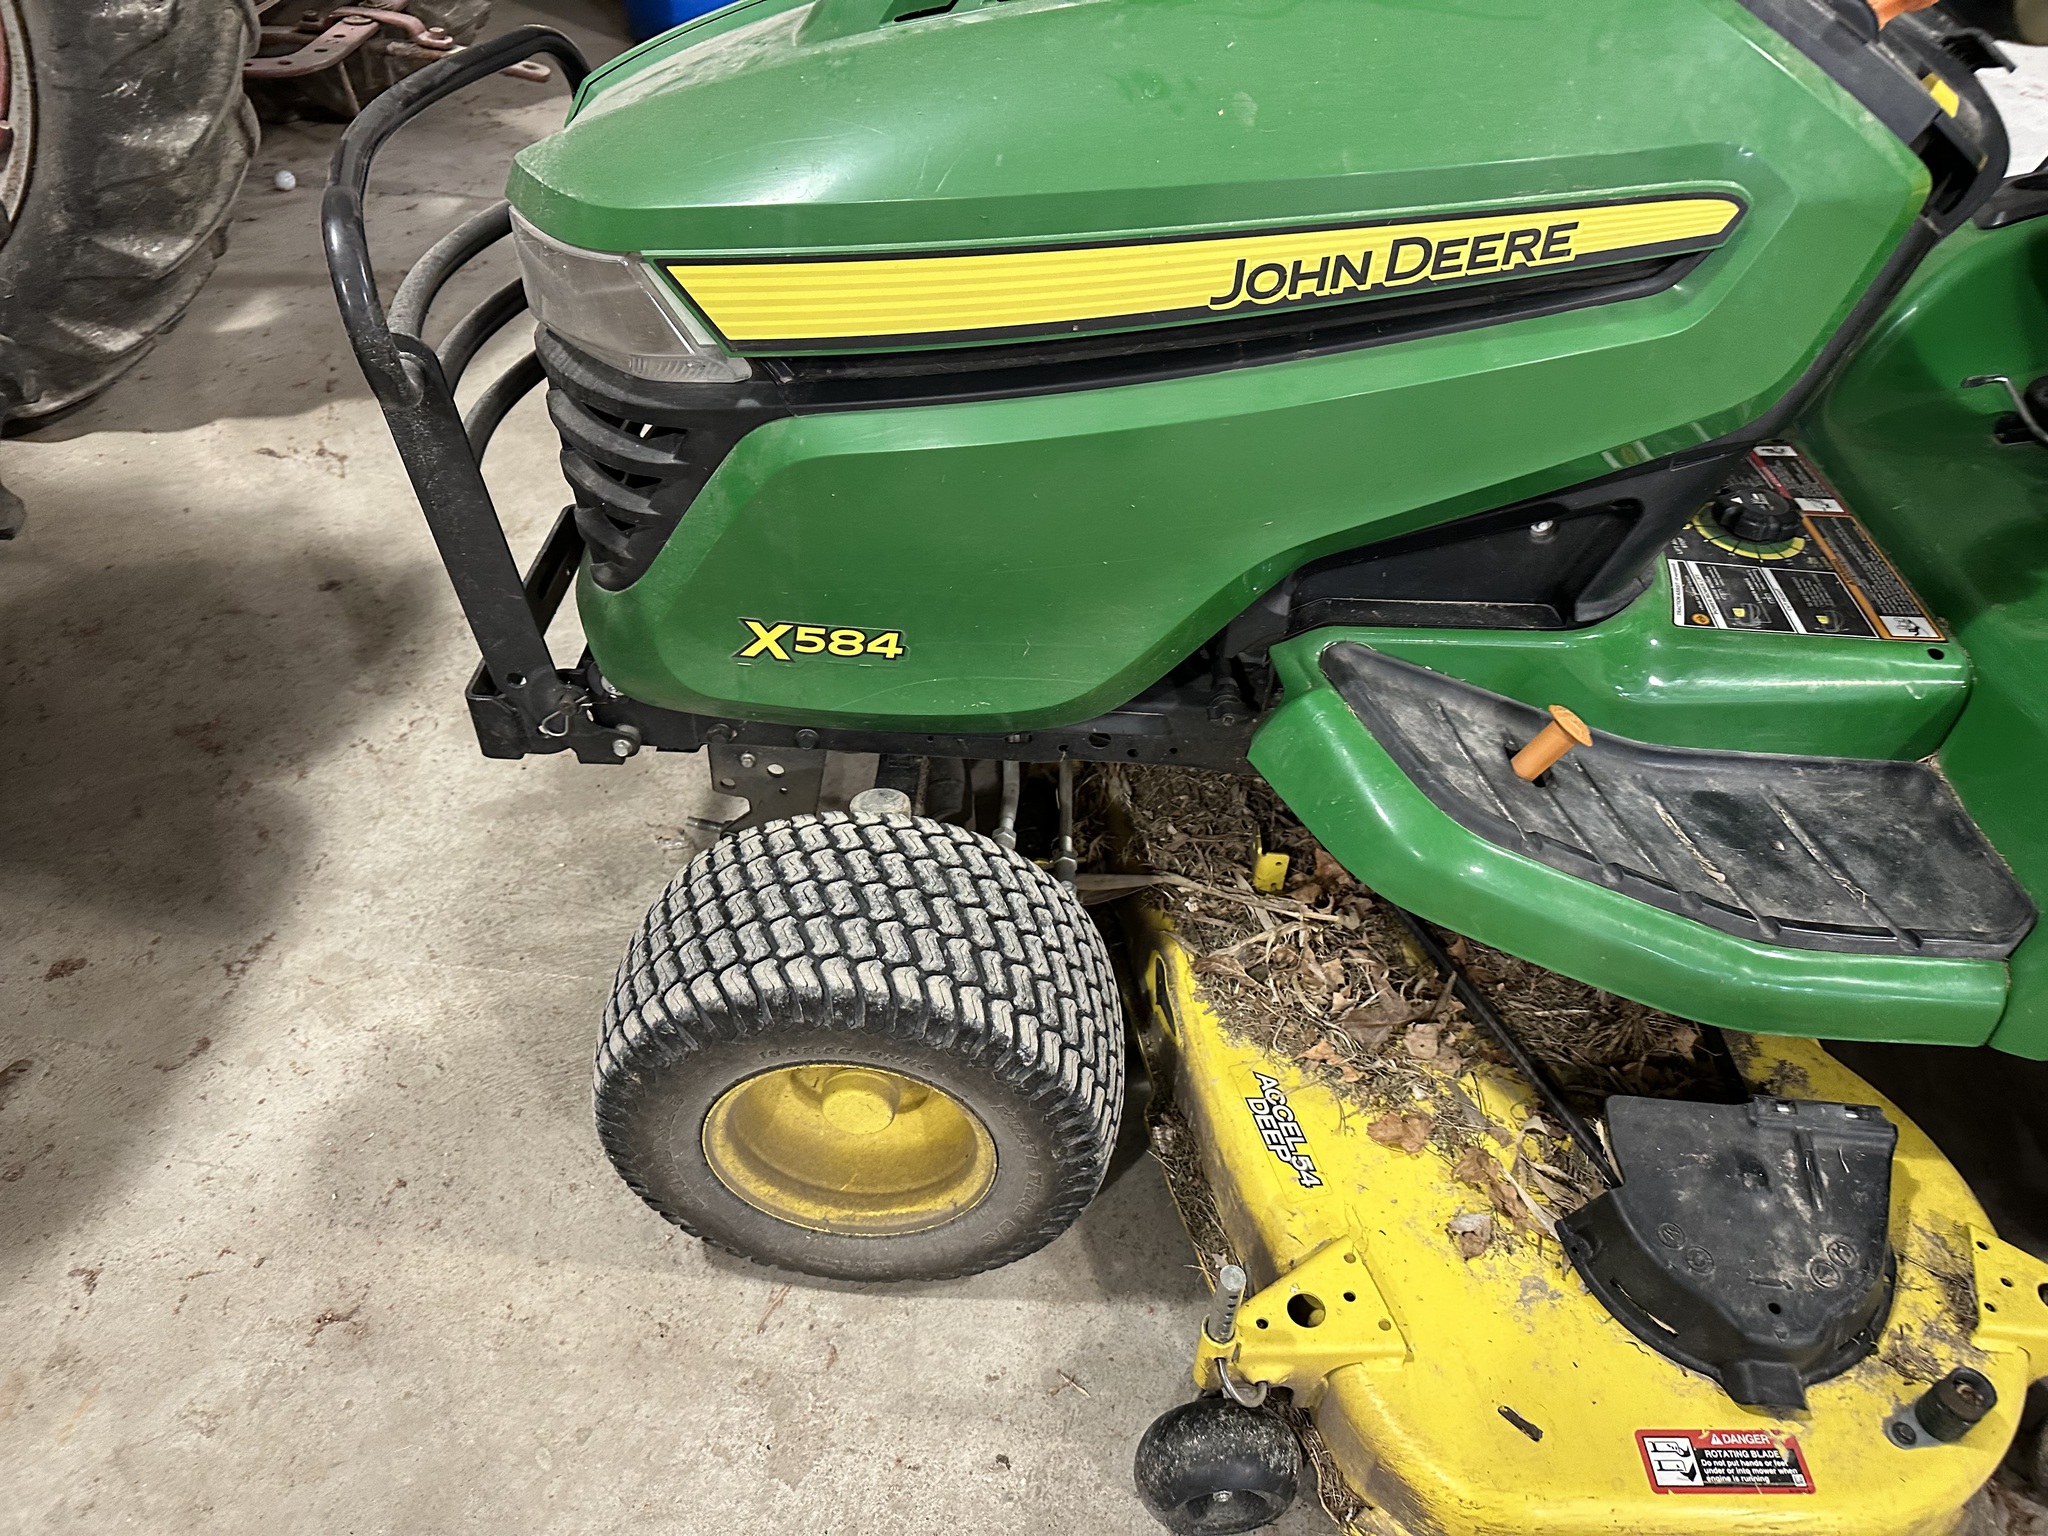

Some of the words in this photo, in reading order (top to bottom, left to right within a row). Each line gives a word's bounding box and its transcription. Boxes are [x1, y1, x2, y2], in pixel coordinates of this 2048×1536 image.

[1209, 250, 1373, 306] JOHN
[1384, 221, 1579, 281] DEERE
[1708, 598, 1719, 615] POWER
[734, 618, 905, 662] X584
[1245, 1098, 1291, 1163] DEEP
[1253, 1071, 1307, 1152] ACCEL
[1291, 1154, 1323, 1188] 54
[1722, 1433, 1770, 1445] DANGER
[1704, 1450, 1751, 1458] ROTATING
[1751, 1450, 1781, 1458] BLADE
[1727, 1460, 1740, 1469] put
[1736, 1467, 1751, 1475] into
[1706, 1476, 1732, 1484] engine
[1732, 1475, 1740, 1483] is
[1740, 1476, 1770, 1484] running
